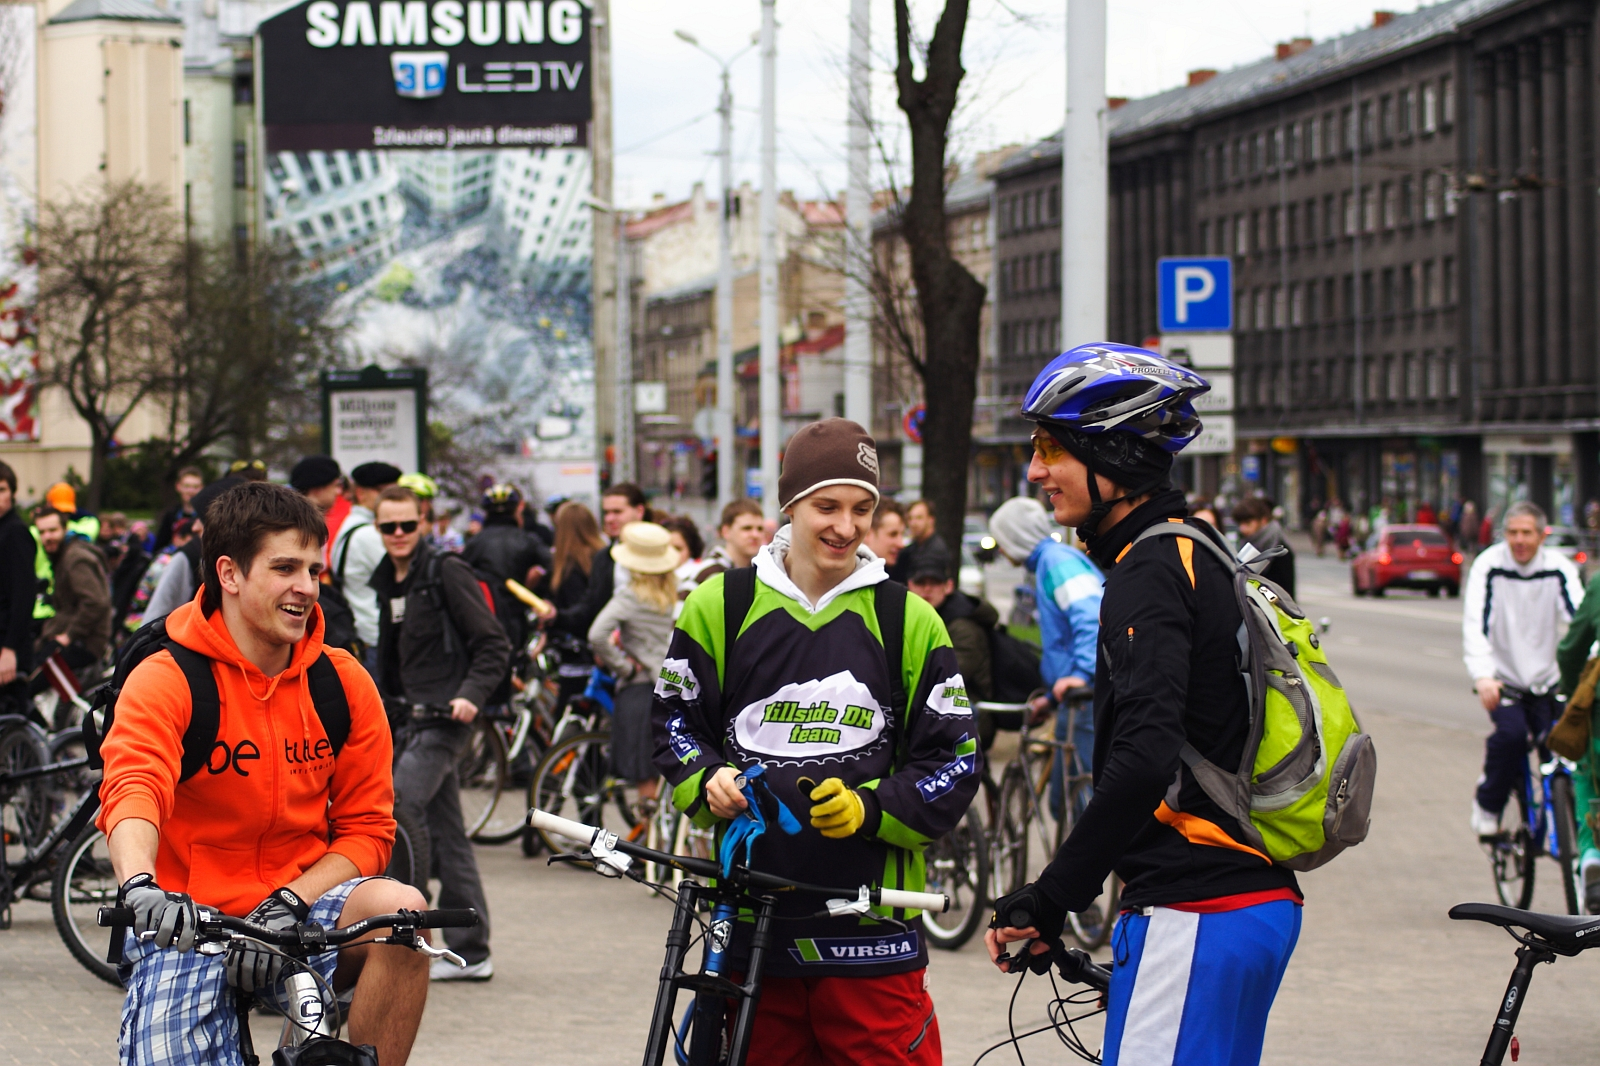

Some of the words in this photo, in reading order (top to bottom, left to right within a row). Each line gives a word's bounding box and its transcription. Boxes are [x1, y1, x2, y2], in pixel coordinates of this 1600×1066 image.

[306, 0, 583, 48] SAMSUNG
[394, 62, 448, 91] 3D
[1174, 266, 1216, 324] P
[1131, 367, 1173, 376] PROWELL
[787, 724, 842, 745] team
